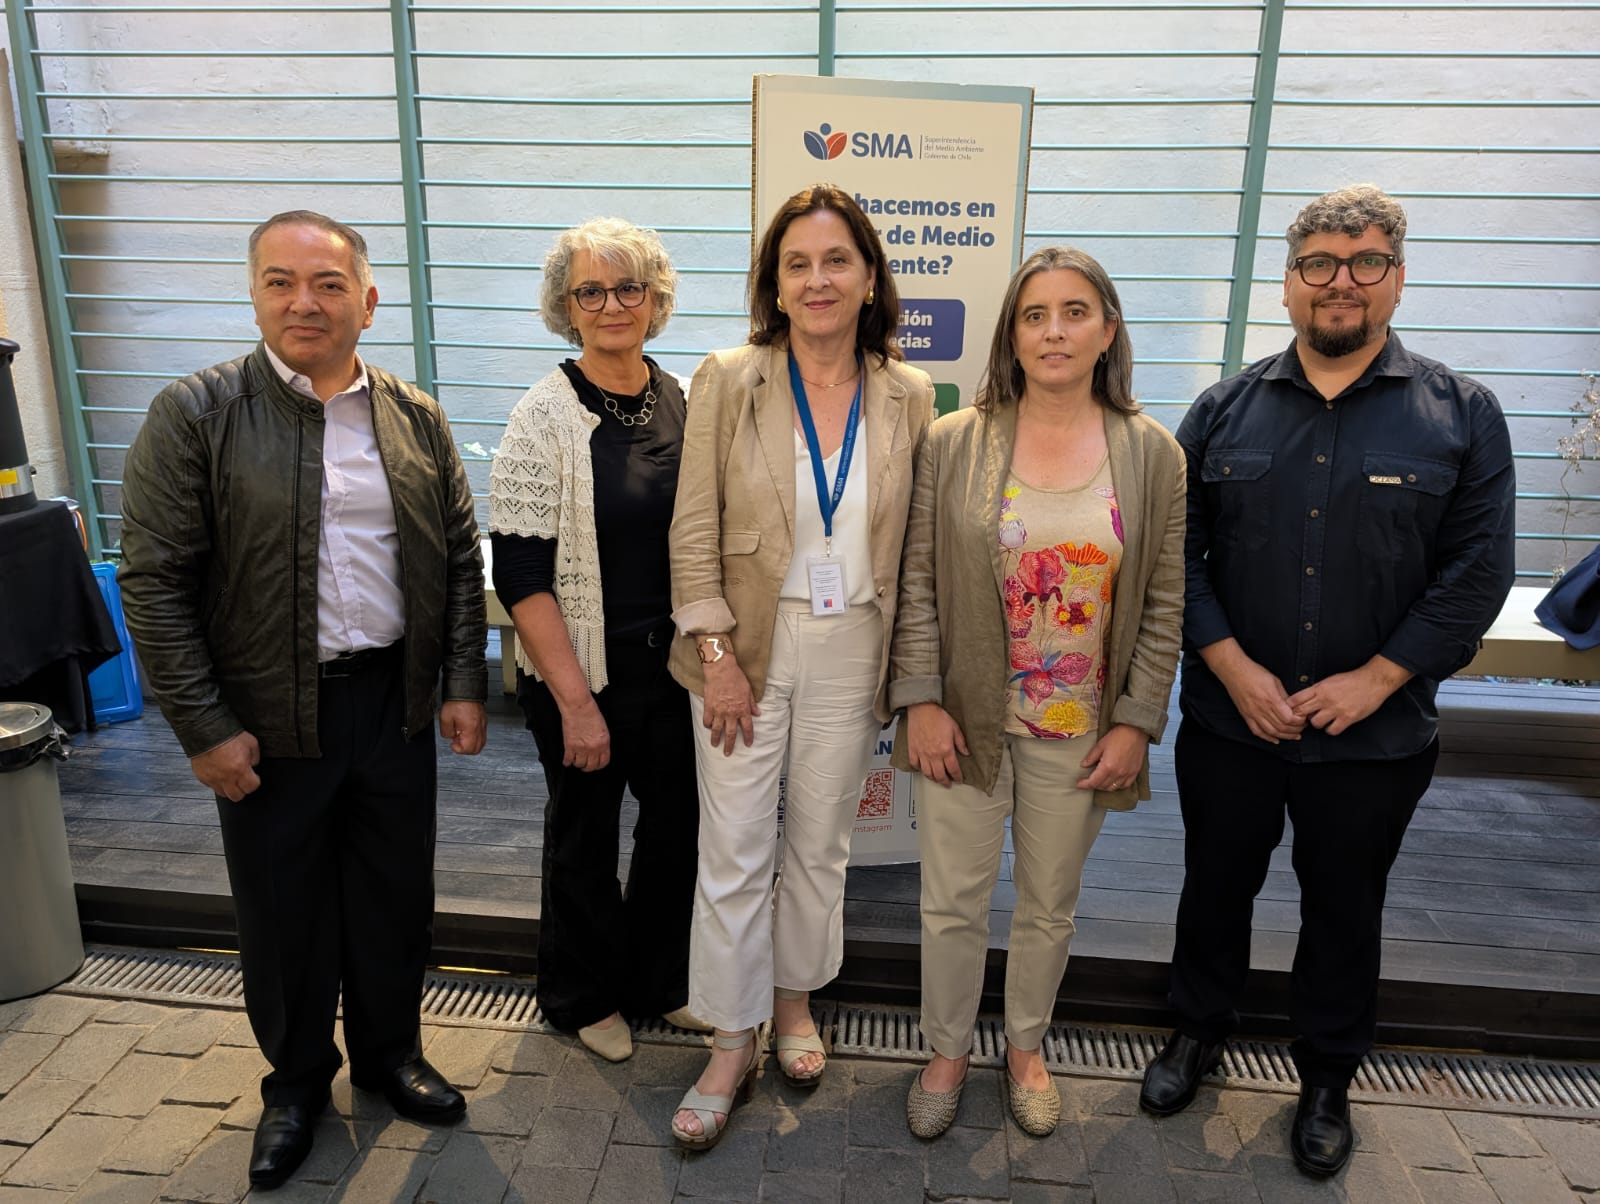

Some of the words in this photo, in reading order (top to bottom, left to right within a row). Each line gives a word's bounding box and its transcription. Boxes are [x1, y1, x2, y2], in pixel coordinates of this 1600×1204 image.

[851, 132, 913, 159] SMA
[924, 136, 976, 144] Superintendencia
[855, 193, 961, 217] hacemos
[967, 202, 995, 218] en
[887, 225, 915, 245] de
[922, 225, 995, 247] Medio
[887, 255, 953, 275] ente?
